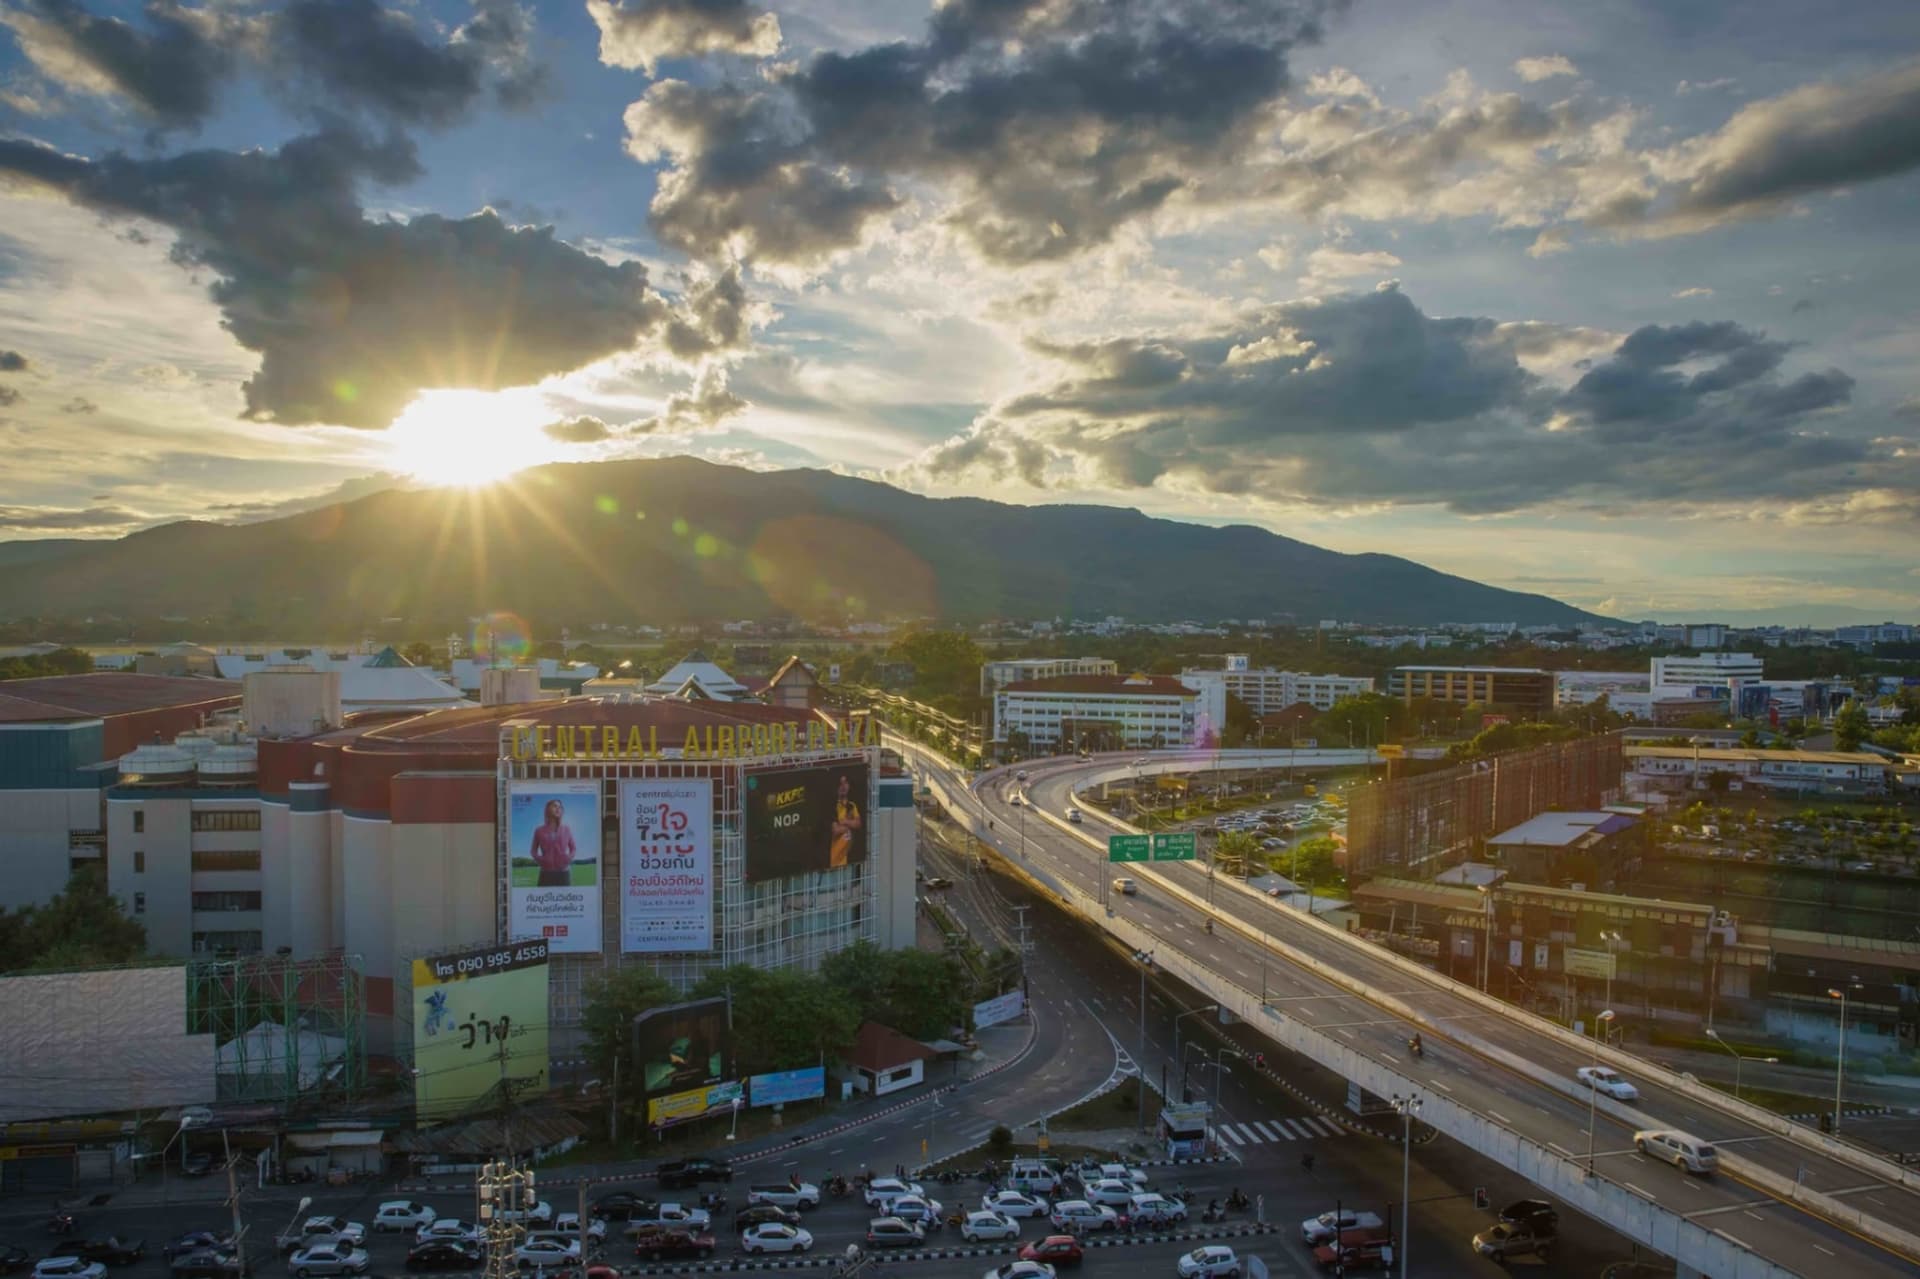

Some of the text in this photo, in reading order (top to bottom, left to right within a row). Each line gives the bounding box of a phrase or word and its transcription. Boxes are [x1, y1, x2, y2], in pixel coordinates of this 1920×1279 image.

[512, 715, 881, 760] CENTRAL AIRPORT PLAZA
[657, 803, 689, 831] ใจ
[773, 812, 800, 829] NOP
[640, 851, 695, 870] ช่วยกัน
[457, 956, 484, 972] 090
[487, 951, 512, 967] 995
[514, 945, 546, 961] 4558
